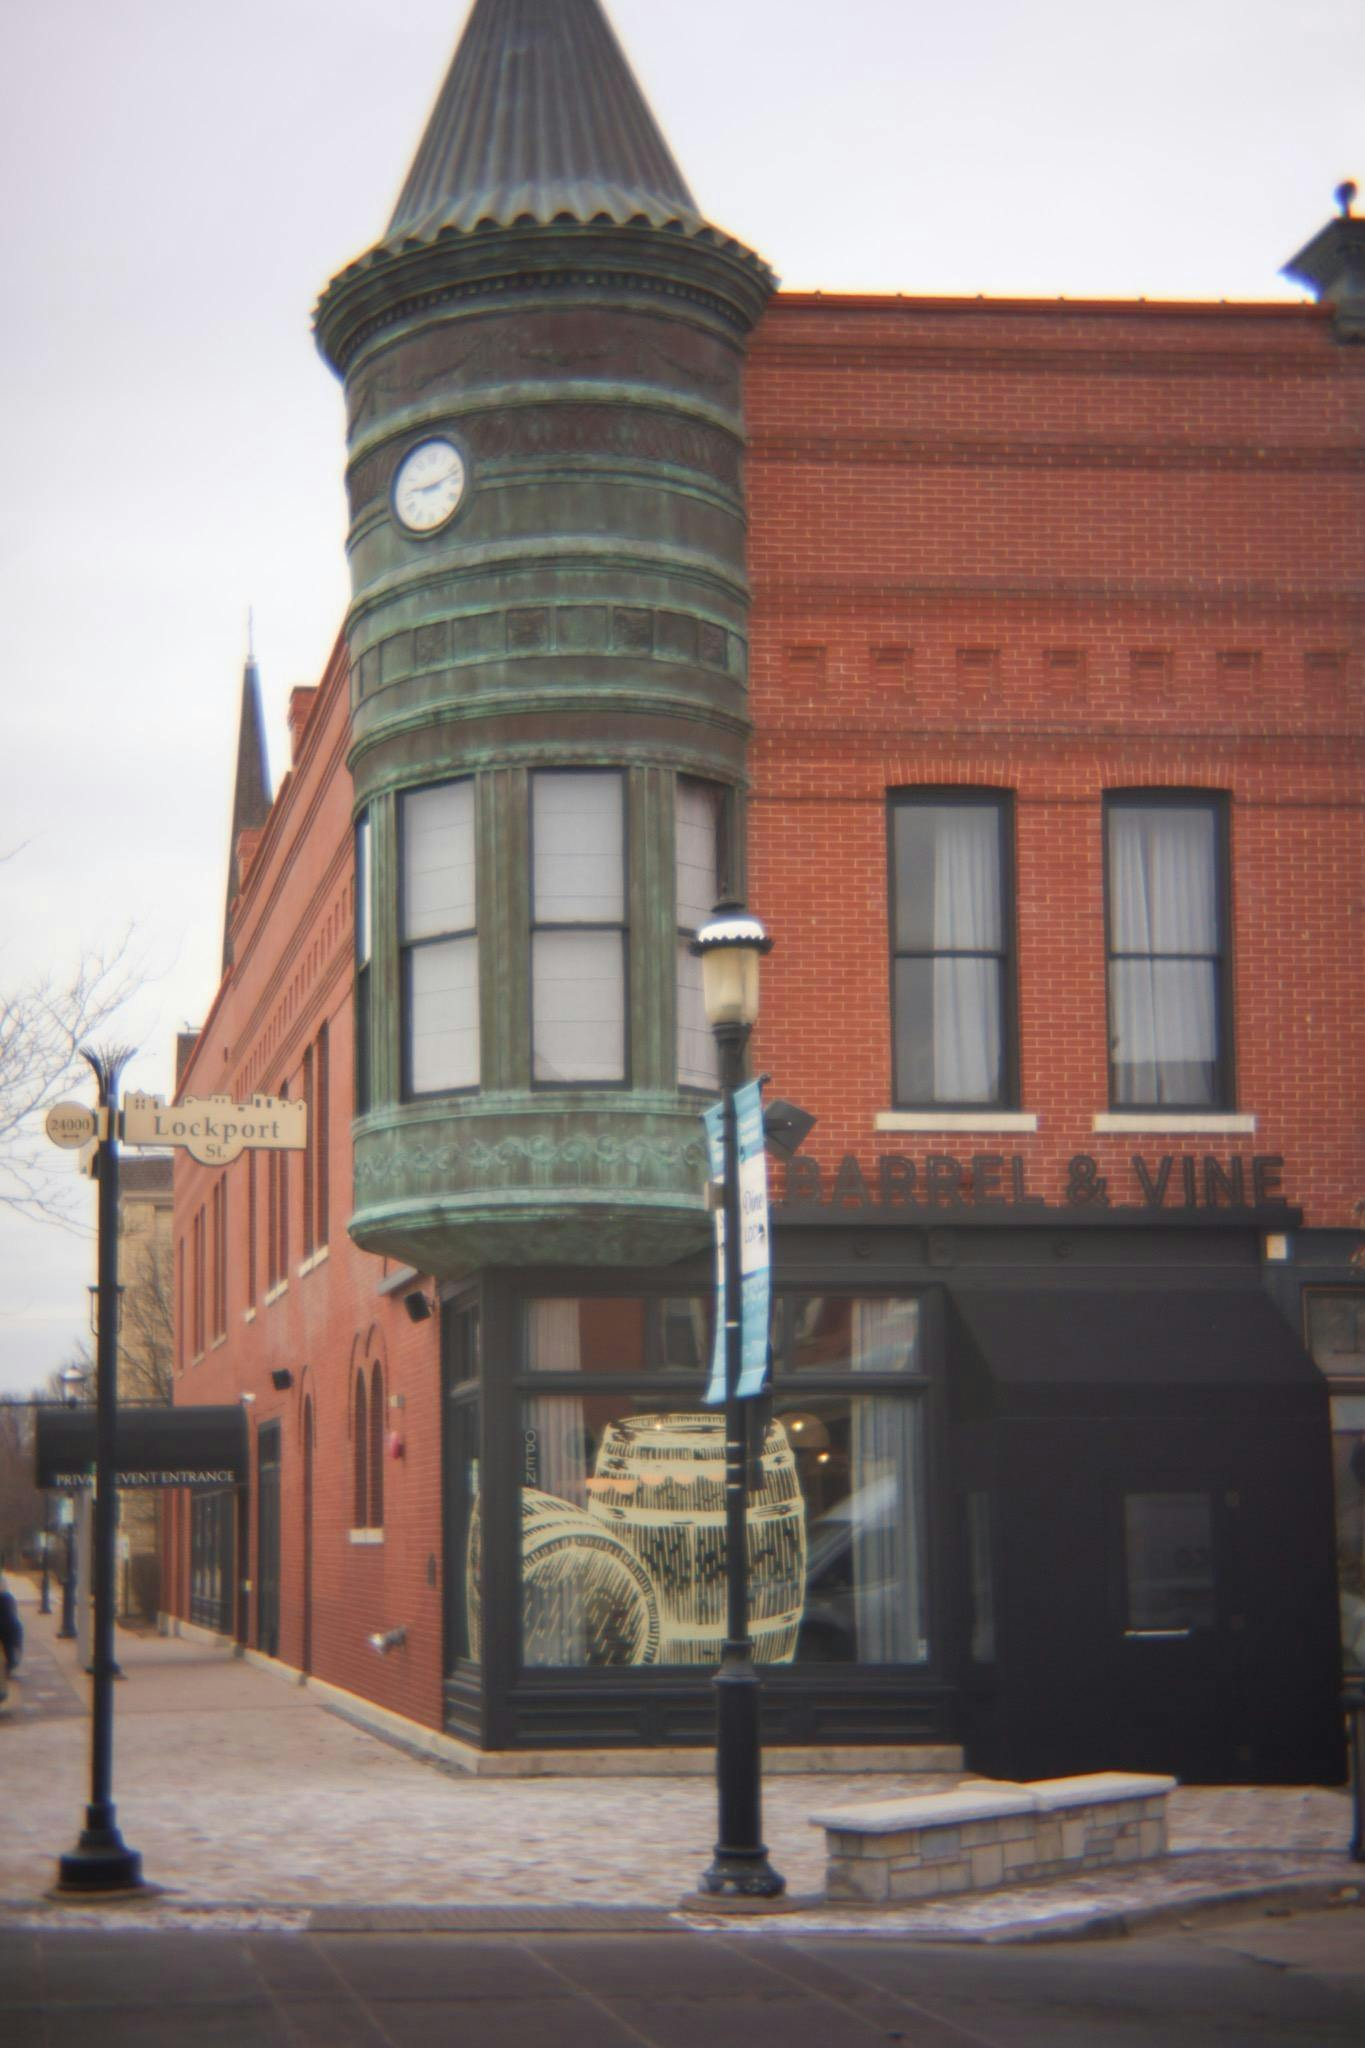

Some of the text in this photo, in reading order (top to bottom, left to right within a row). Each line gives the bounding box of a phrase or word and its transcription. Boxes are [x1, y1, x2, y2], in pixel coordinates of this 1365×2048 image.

[51, 1118, 90, 1131] 24000
[154, 1116, 280, 1144] Lockport
[205, 1144, 226, 1159] St.
[784, 1154, 1287, 1208] BARREL & VINE
[525, 1430, 536, 1485] OPEN
[161, 1470, 235, 1484] ENTRANCE
